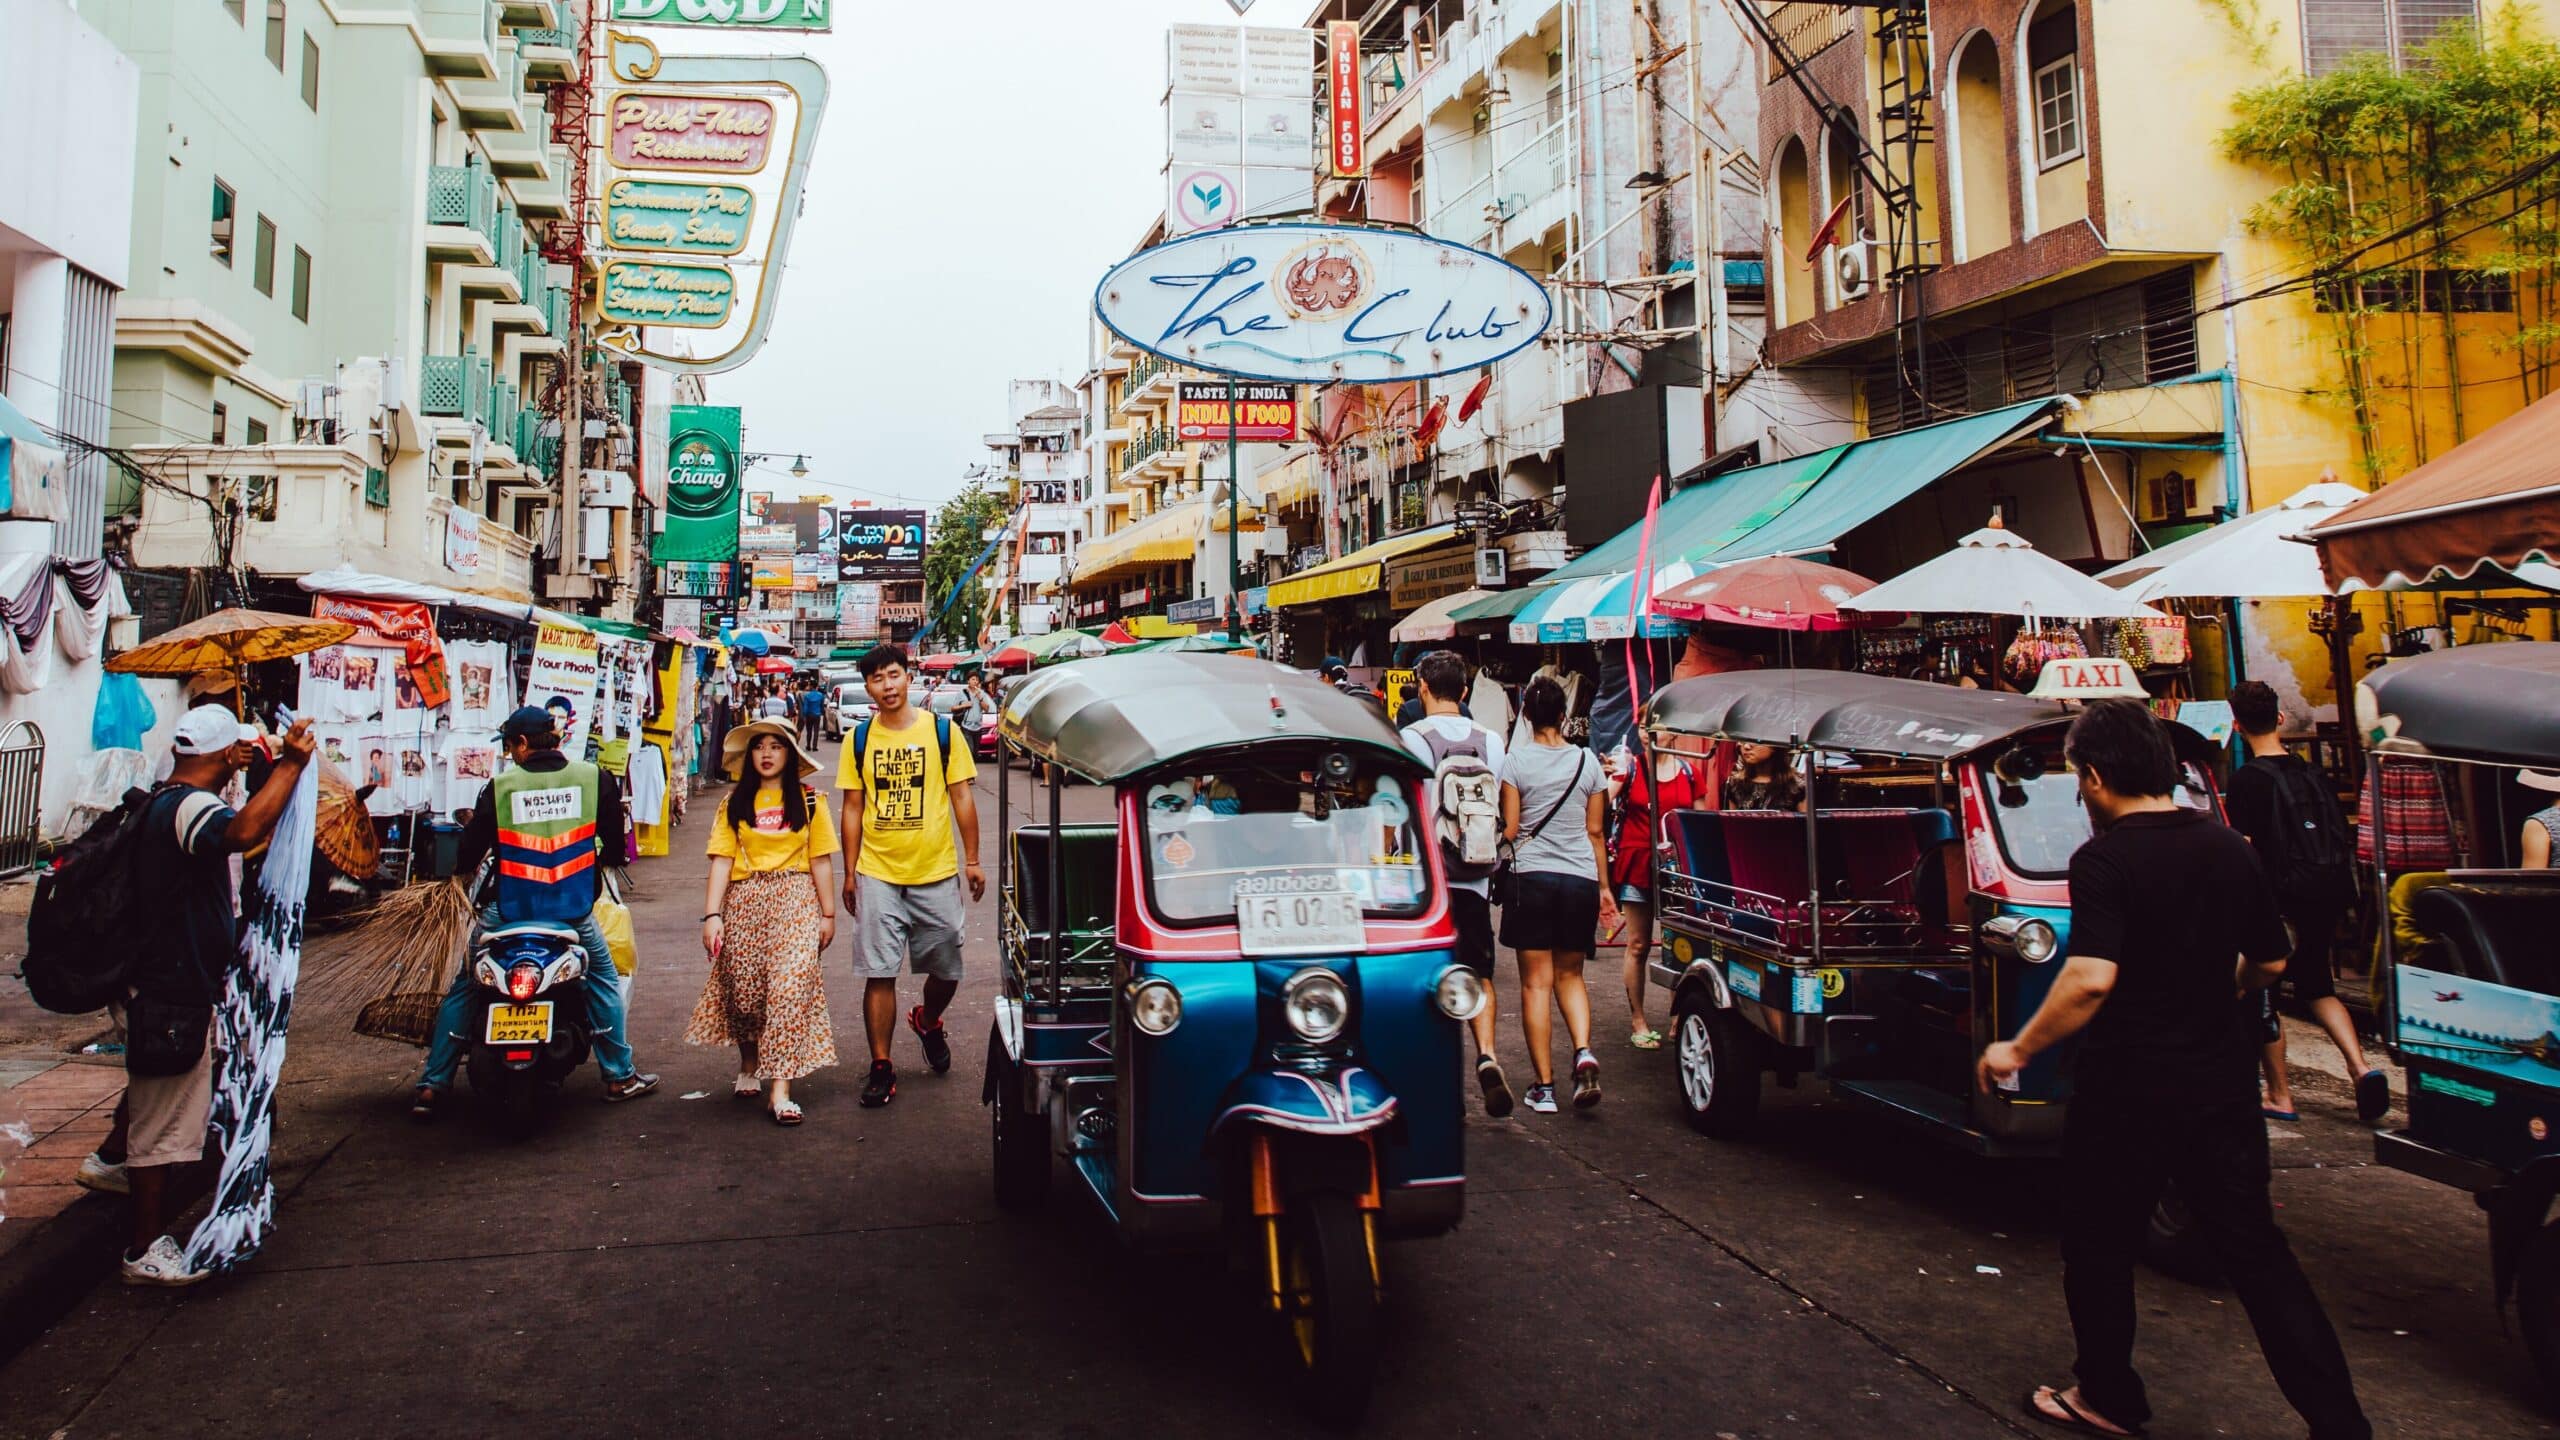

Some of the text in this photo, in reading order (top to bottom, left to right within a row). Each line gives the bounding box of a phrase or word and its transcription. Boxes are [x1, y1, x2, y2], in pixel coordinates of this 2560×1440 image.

[1339, 40, 1353, 109] INDIAN
[1341, 121, 1354, 167] FOOD
[702, 186, 750, 216] Pool
[614, 212, 737, 248] Beauty Salon
[609, 265, 731, 299] Thai Massage
[607, 287, 677, 319] Shopping
[1149, 256, 1520, 350] The Club
[1184, 386, 1228, 400] TASTE
[1249, 386, 1288, 400] INDIA
[1180, 403, 1292, 425] INDIAN FOOD
[667, 466, 727, 489] Chang
[541, 627, 563, 646] MADE
[537, 657, 596, 675] Your Photo
[2055, 664, 2124, 688] TAXI
[894, 748, 913, 762] AM
[878, 761, 920, 776] ONE OF
[523, 793, 573, 807] พระนคร
